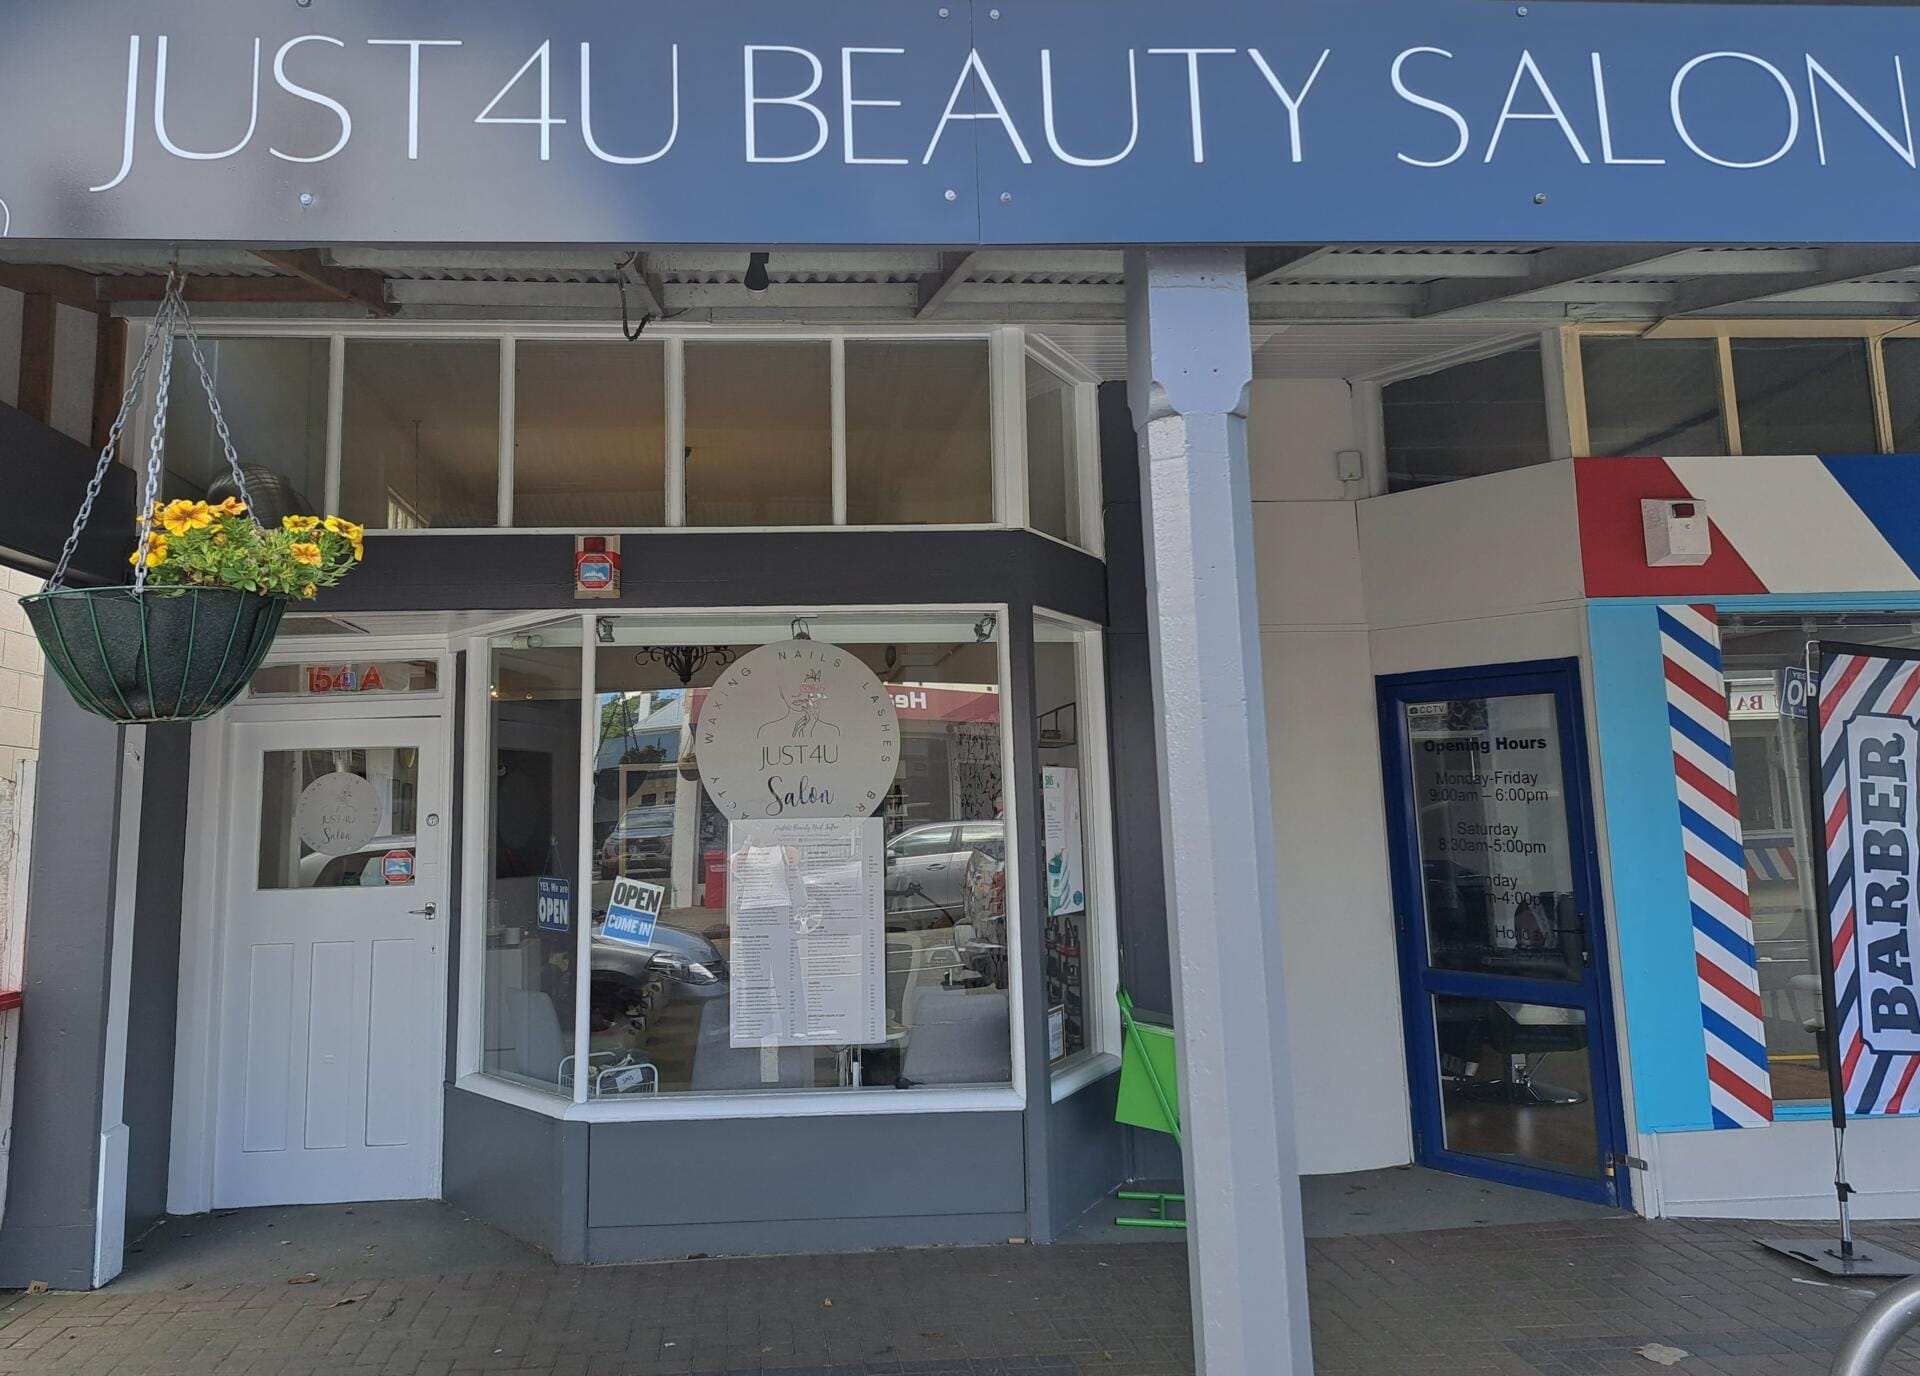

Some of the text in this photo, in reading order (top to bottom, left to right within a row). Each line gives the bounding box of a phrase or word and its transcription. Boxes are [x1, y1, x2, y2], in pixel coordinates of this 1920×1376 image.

[744, 44, 1331, 167] BEAUTY
[1391, 46, 1917, 169] SALON
[777, 650, 842, 668] NAILS
[361, 663, 384, 690] A
[704, 667, 752, 744] WAXING
[1419, 704, 1445, 715] CCTV
[861, 681, 892, 763] LASHES
[759, 743, 839, 771] JUST4U
[1424, 737, 1547, 755] Opening Hours
[1435, 771, 1539, 787] Monday-Friday
[765, 775, 835, 816] Salon
[1495, 788, 1549, 804] 6:00pm
[1457, 822, 1518, 838] Saturday
[1859, 731, 1920, 1035] BARBER
[538, 896, 568, 925] OPEN
[613, 882, 661, 914] OPEN
[607, 914, 651, 937] COME IN
